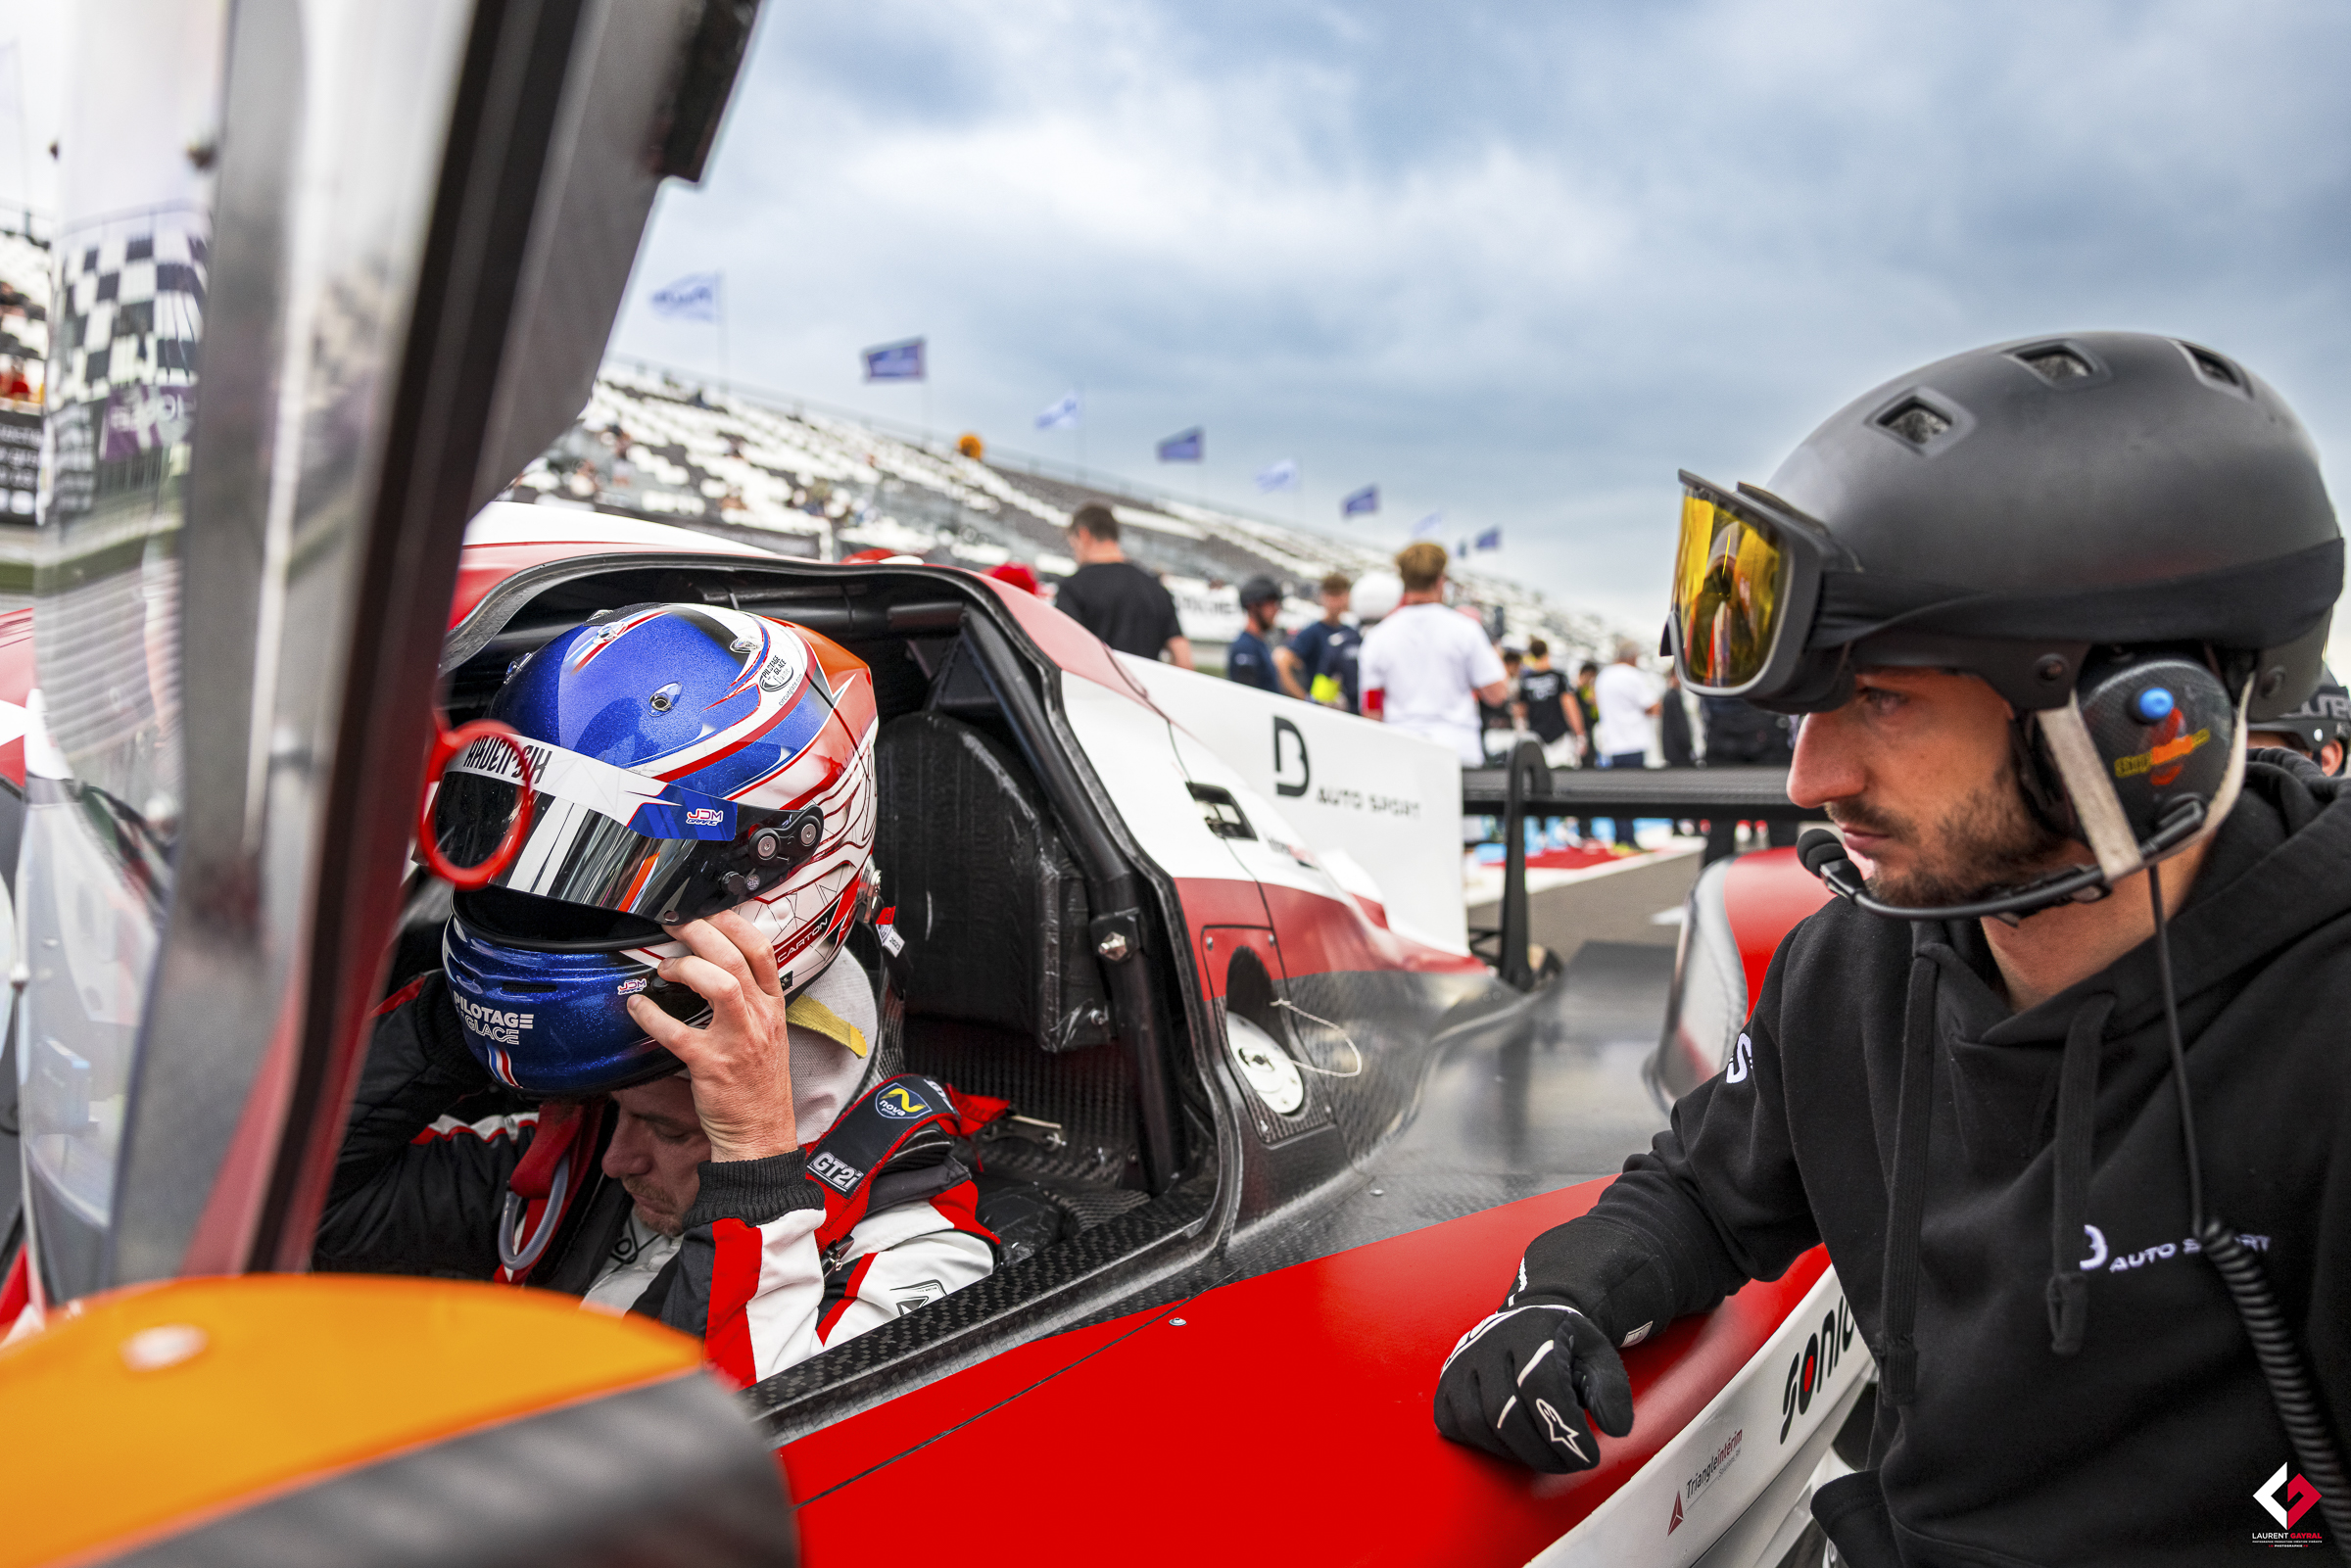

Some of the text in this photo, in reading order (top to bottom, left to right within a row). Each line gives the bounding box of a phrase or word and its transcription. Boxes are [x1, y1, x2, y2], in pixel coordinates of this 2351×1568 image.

[688, 808, 723, 821] JDM
[1317, 786, 1420, 820] AUTO SPORT
[777, 918, 829, 964] CARTON
[618, 979, 646, 991] JDM
[454, 990, 535, 1029] PILOTAGE
[464, 1015, 520, 1046] GLACE
[879, 1099, 906, 1117] nova
[809, 1151, 864, 1190] GT2i
[2109, 1242, 2178, 1273] AUTO
